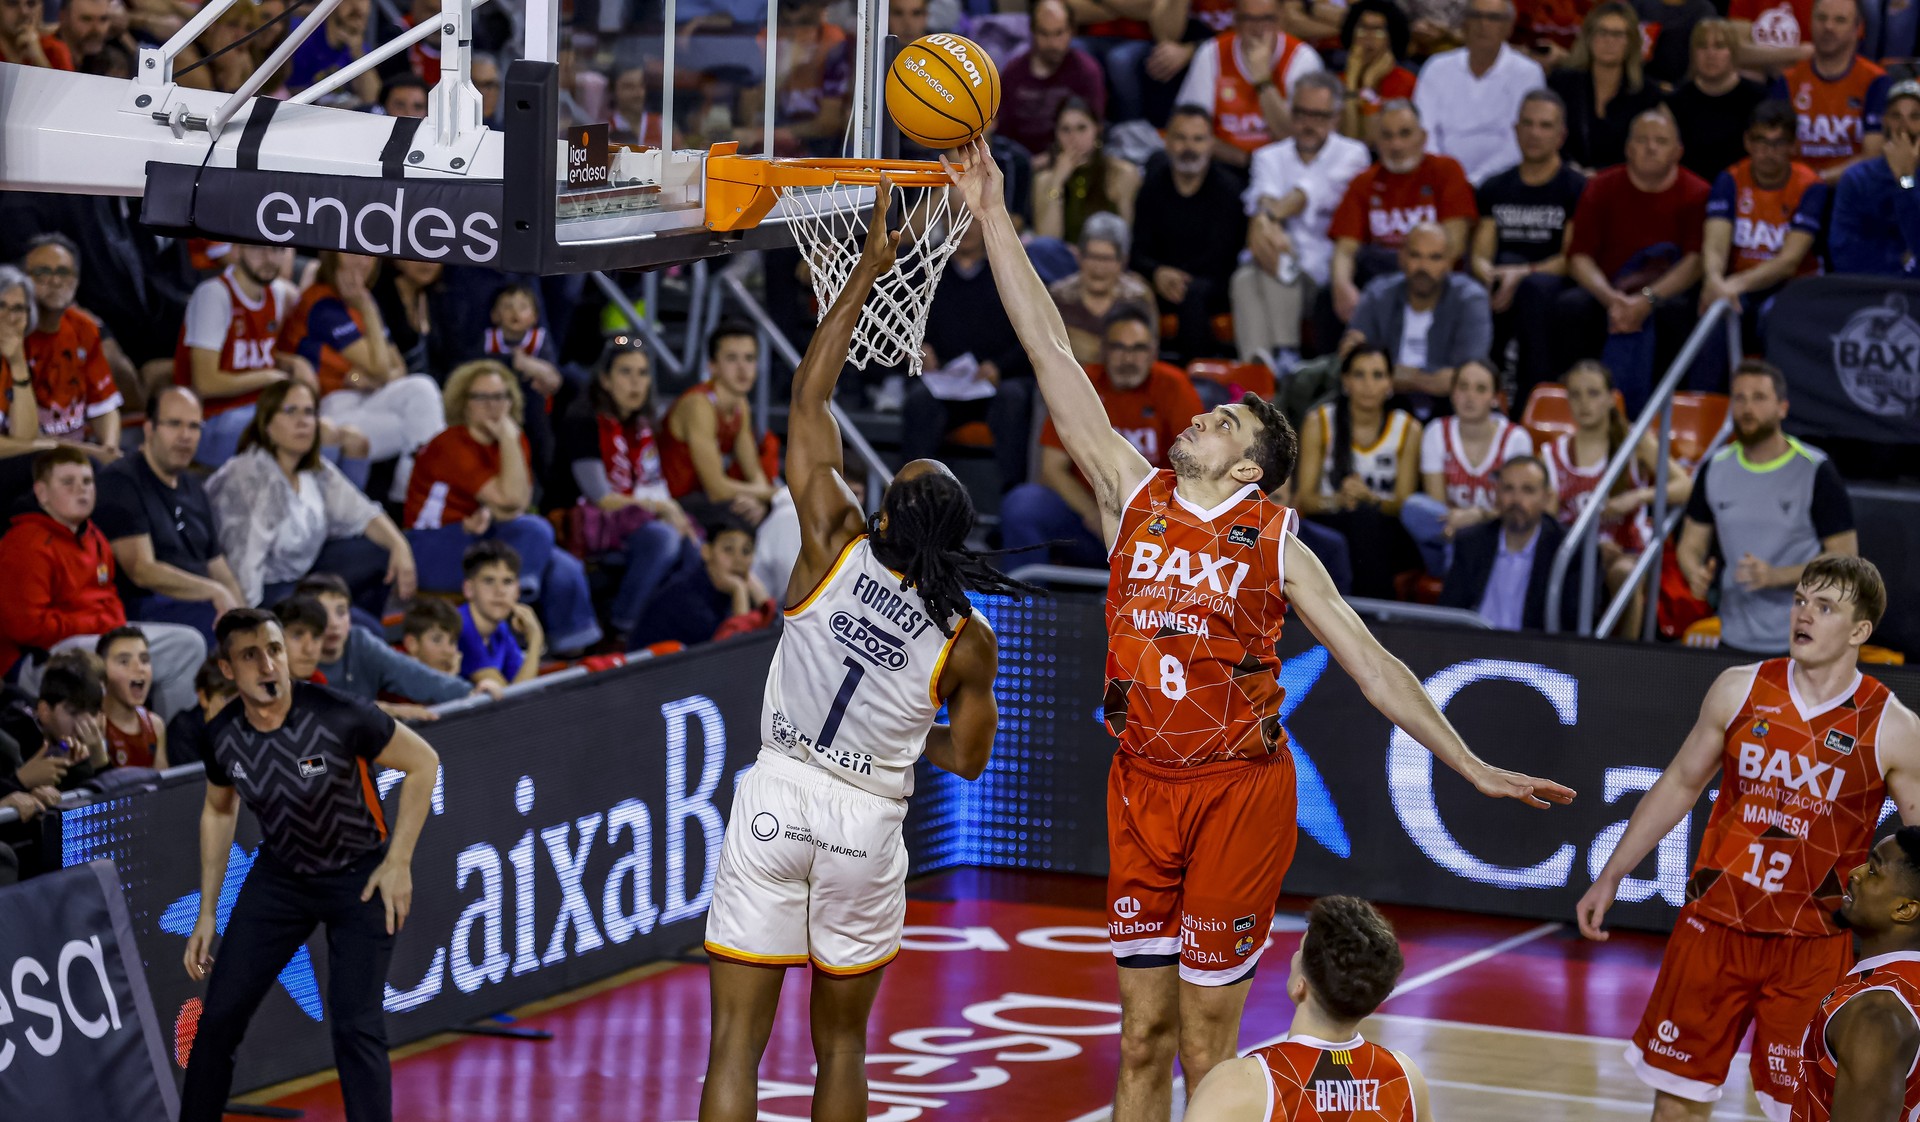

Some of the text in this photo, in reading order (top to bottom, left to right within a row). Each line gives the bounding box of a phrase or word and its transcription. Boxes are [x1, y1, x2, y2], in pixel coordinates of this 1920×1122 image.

[904, 56, 955, 104] liga endesa
[926, 34, 983, 88] Wilson
[569, 144, 587, 166] liga
[569, 163, 606, 184] endesa
[256, 188, 500, 263] endes
[1128, 541, 1250, 599] BAXI
[852, 572, 934, 640] FORREST
[1125, 583, 1235, 618] CLIMATIZACIÓN
[1132, 608, 1210, 639] MANRESA
[1159, 653, 1187, 701] 8
[817, 655, 865, 748] 1
[1738, 742, 1846, 802] BAXI
[1739, 780, 1833, 816] CLIMATIZACIÓN
[1743, 804, 1809, 840] MANRESA
[376, 694, 757, 1013] aixaB
[816, 839, 829, 851] DE
[830, 844, 867, 858] MURCIA
[1742, 843, 1792, 893] 12
[1236, 921, 1251, 931] acb
[1768, 1056, 1788, 1073] ETL
[1315, 1079, 1381, 1112] BENITEZ
